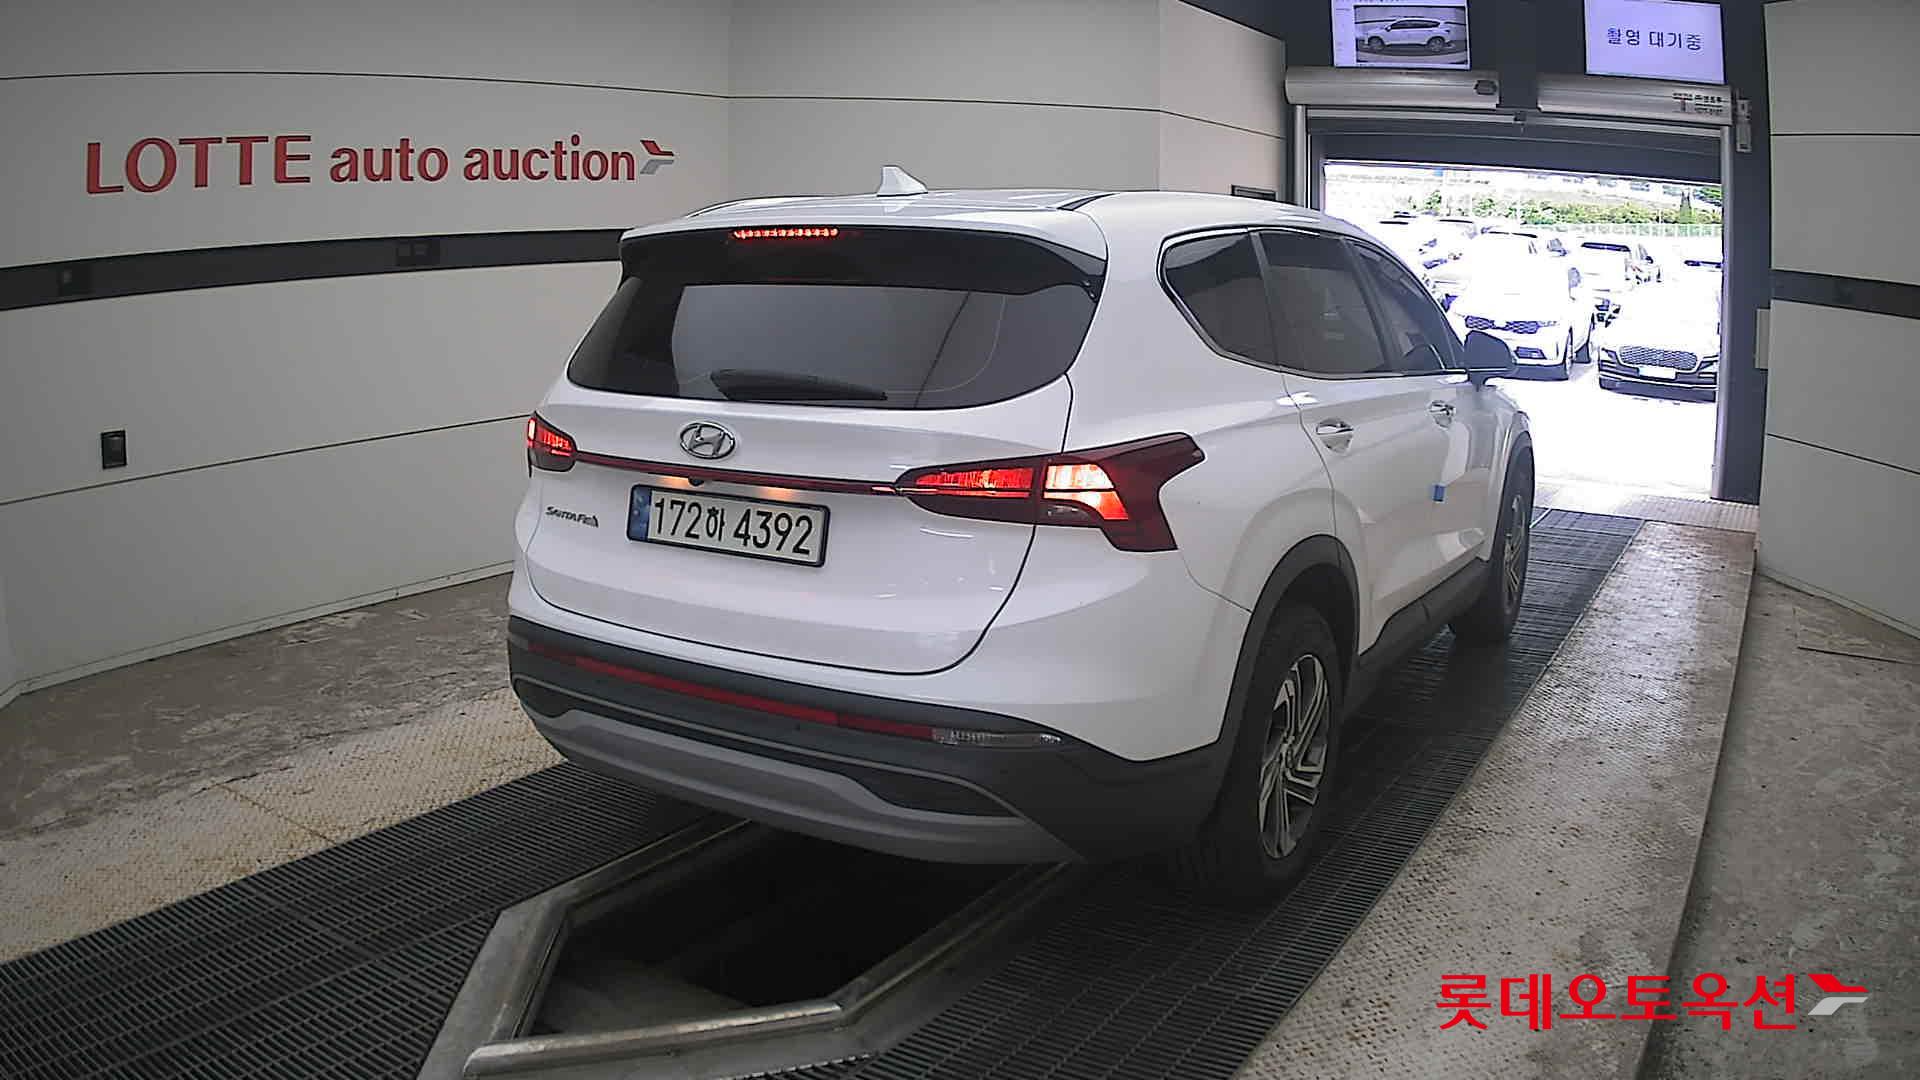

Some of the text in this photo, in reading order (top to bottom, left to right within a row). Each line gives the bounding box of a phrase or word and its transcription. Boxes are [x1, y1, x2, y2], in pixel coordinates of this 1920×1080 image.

[1649, 31, 1701, 51] 대기중
[86, 134, 635, 194] LOTTE auto auction
[654, 497, 813, 555] 172하 4392
